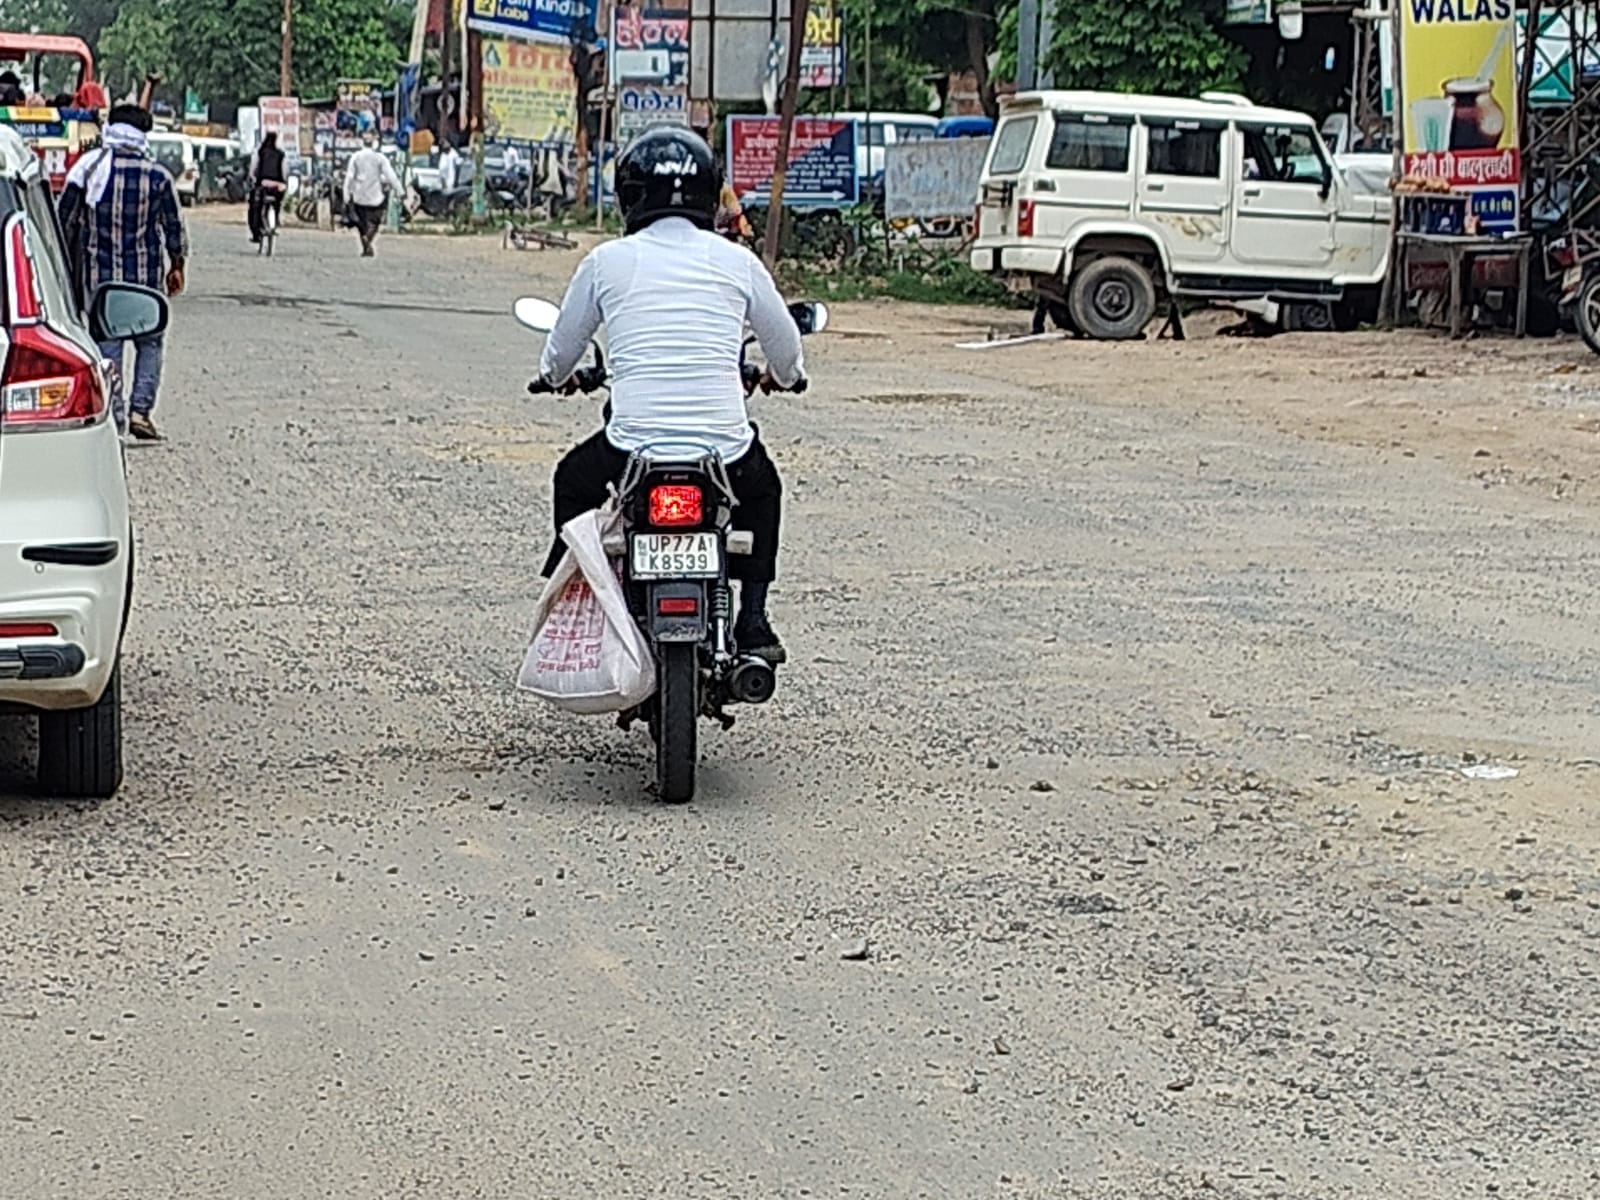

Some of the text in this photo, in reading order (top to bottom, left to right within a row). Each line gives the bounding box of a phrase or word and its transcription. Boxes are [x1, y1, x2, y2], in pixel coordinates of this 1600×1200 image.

[1411, 0, 1510, 23] WALAS
[649, 535, 707, 553] UP77A
[649, 553, 708, 570] K8539
